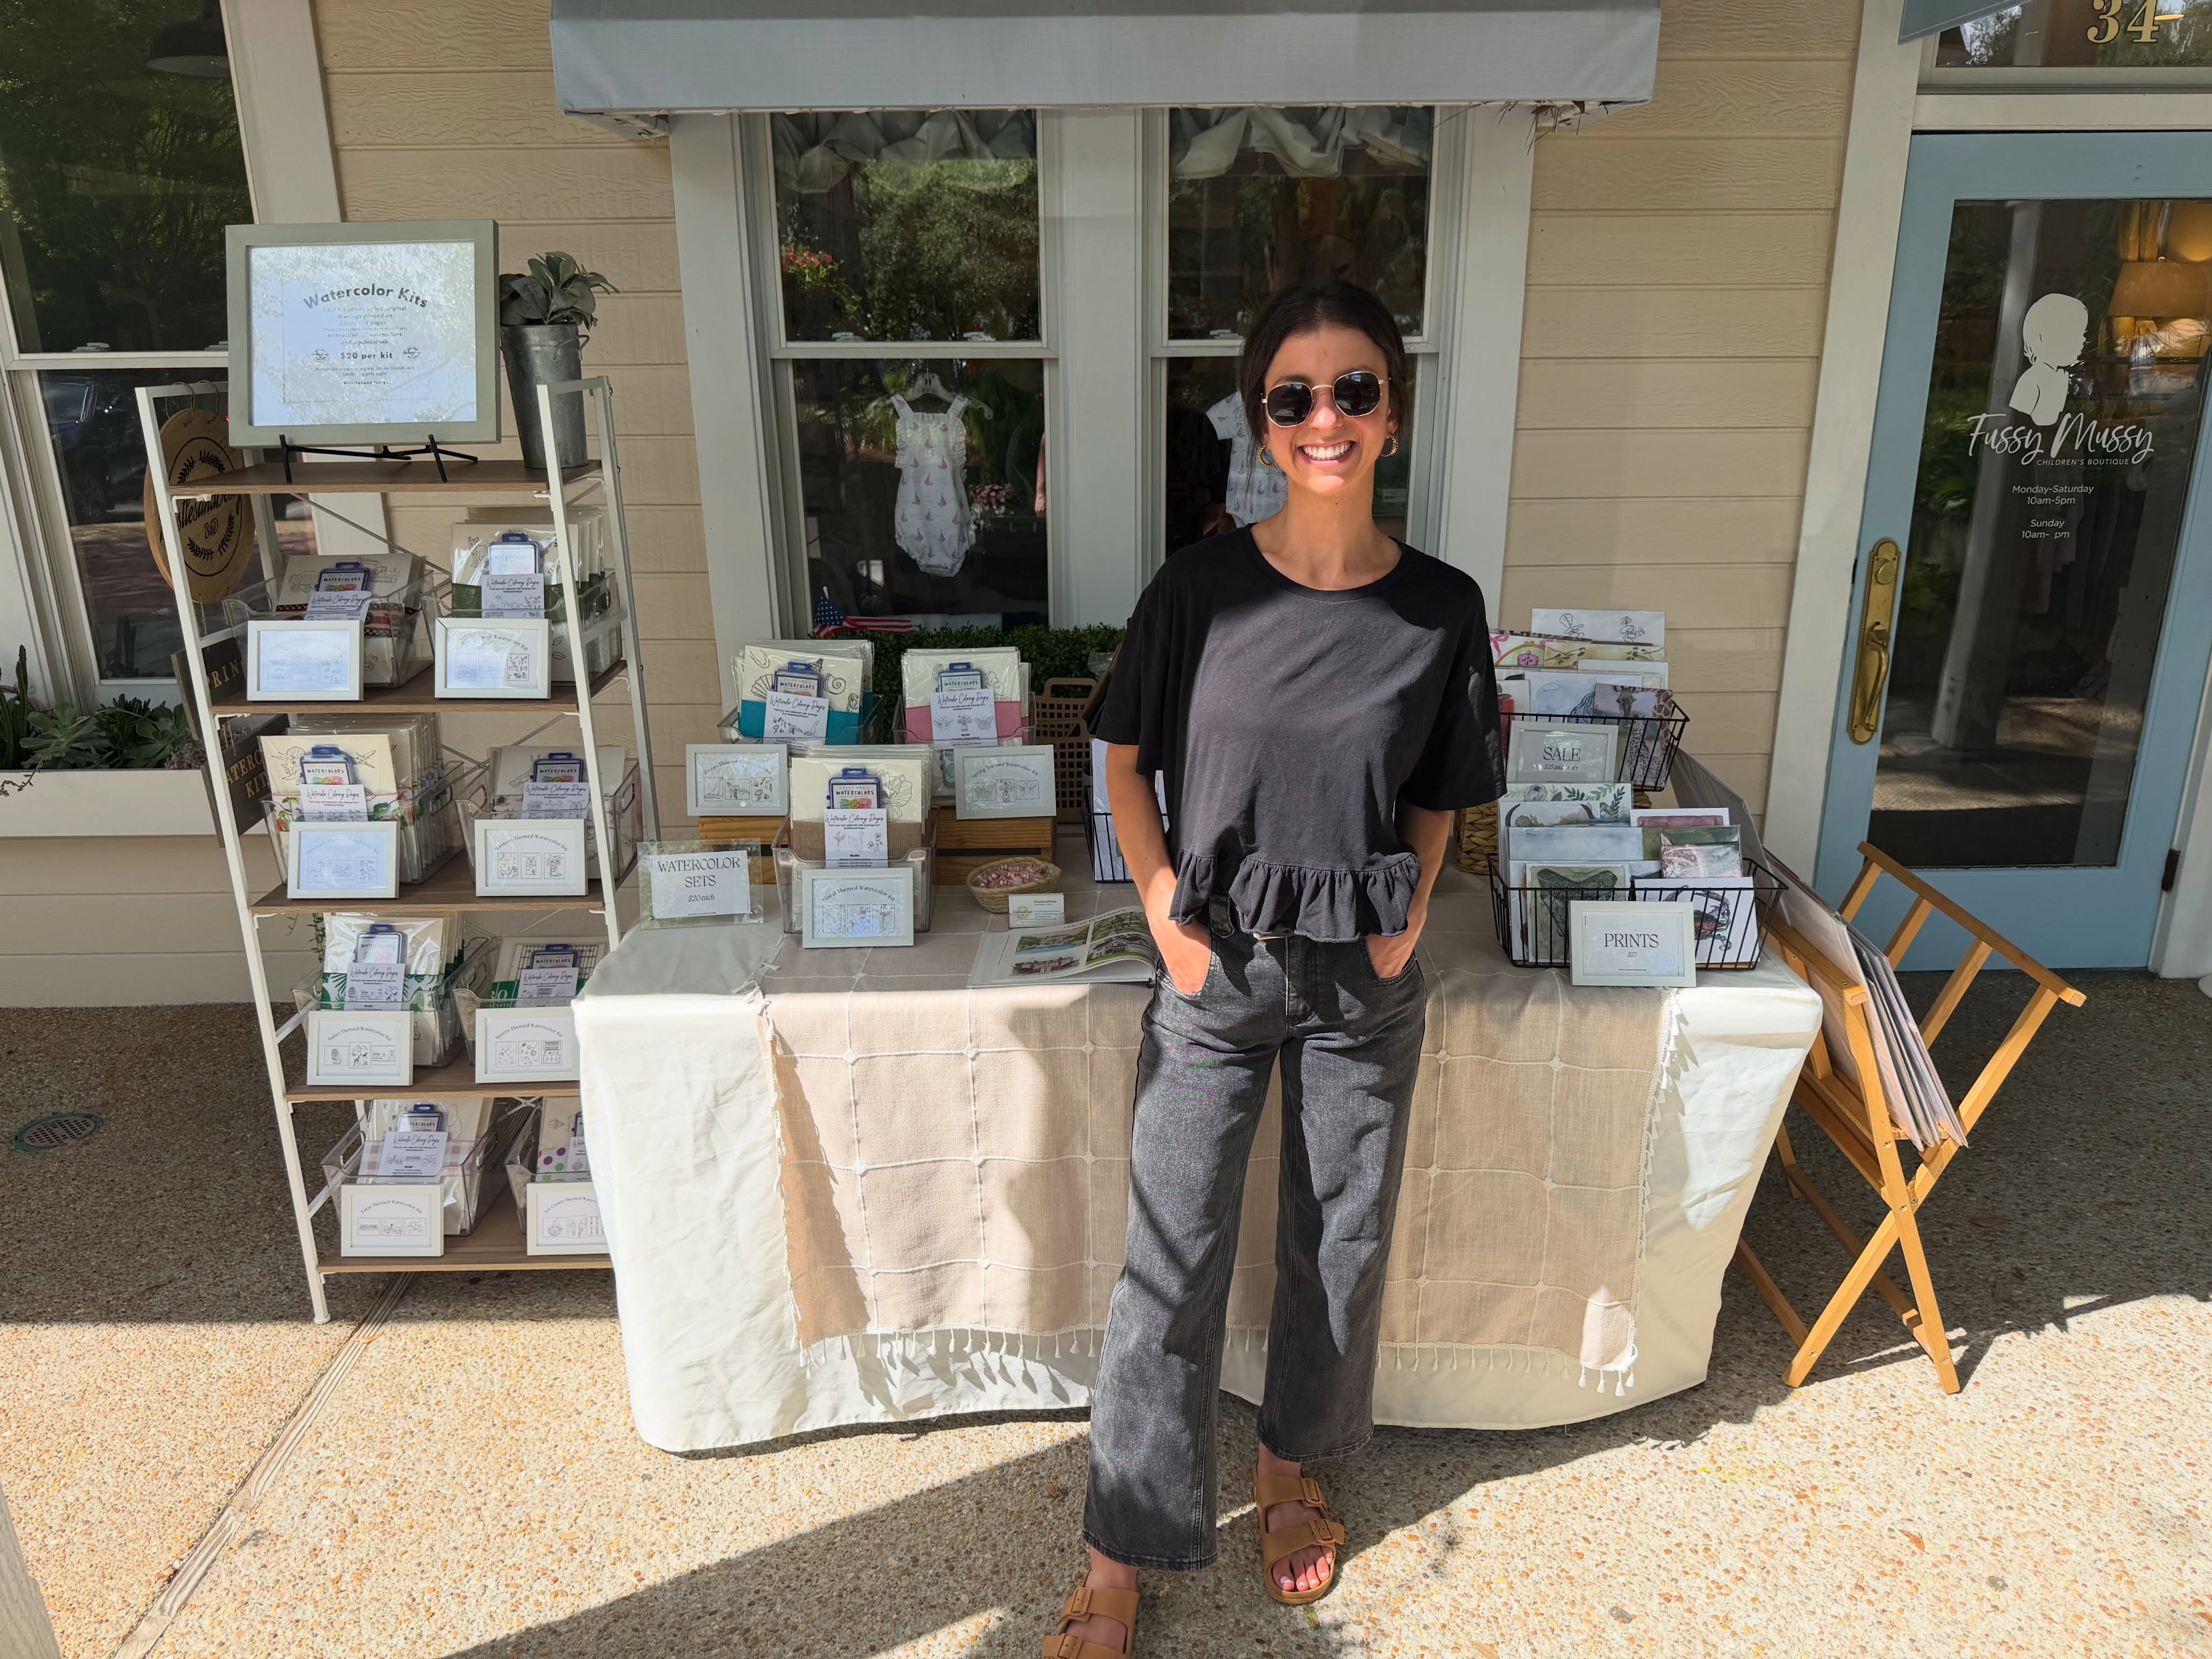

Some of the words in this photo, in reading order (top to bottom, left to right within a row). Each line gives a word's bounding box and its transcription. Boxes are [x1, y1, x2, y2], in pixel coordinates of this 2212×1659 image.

[2087, 0, 2160, 43] 34
[303, 283, 393, 309] Watercolor
[398, 287, 428, 308] Kits
[1967, 413, 2044, 465] Fussy
[2051, 413, 2154, 464] Mussy
[2012, 484, 2094, 494] Monday-Saturday
[2027, 496, 2075, 505] 10am-5pm
[2031, 519, 2065, 528] Sunday
[792, 698, 810, 711] Coloring
[959, 693, 975, 704] Coloring
[1543, 747, 1580, 761] SALE
[226, 750, 262, 784] ATERC
[704, 765, 718, 774] Ocean
[972, 767, 986, 779] Spring
[986, 762, 1004, 770] Themed
[1006, 762, 1031, 772] Watercolor
[825, 814, 847, 824] Watercolor
[849, 813, 867, 824] Coloring
[869, 813, 884, 824] Pages
[495, 839, 513, 851] Western
[535, 834, 562, 846] Watercolor
[658, 857, 740, 873] WATERCOLOR
[685, 875, 716, 888] SETS
[702, 893, 714, 901] each
[822, 891, 837, 902] Floral
[838, 885, 858, 894] Themed
[859, 886, 887, 896] Watercolor
[1604, 933, 1658, 948] PRINTS
[328, 1032, 341, 1041] Safari
[360, 1027, 385, 1037] Watercolor
[495, 1029, 510, 1039] Sports
[530, 1023, 556, 1033] Watercolor
[361, 1205, 372, 1213] Farm
[392, 1200, 415, 1209] Watercolor
[551, 1200, 564, 1209] Cream
